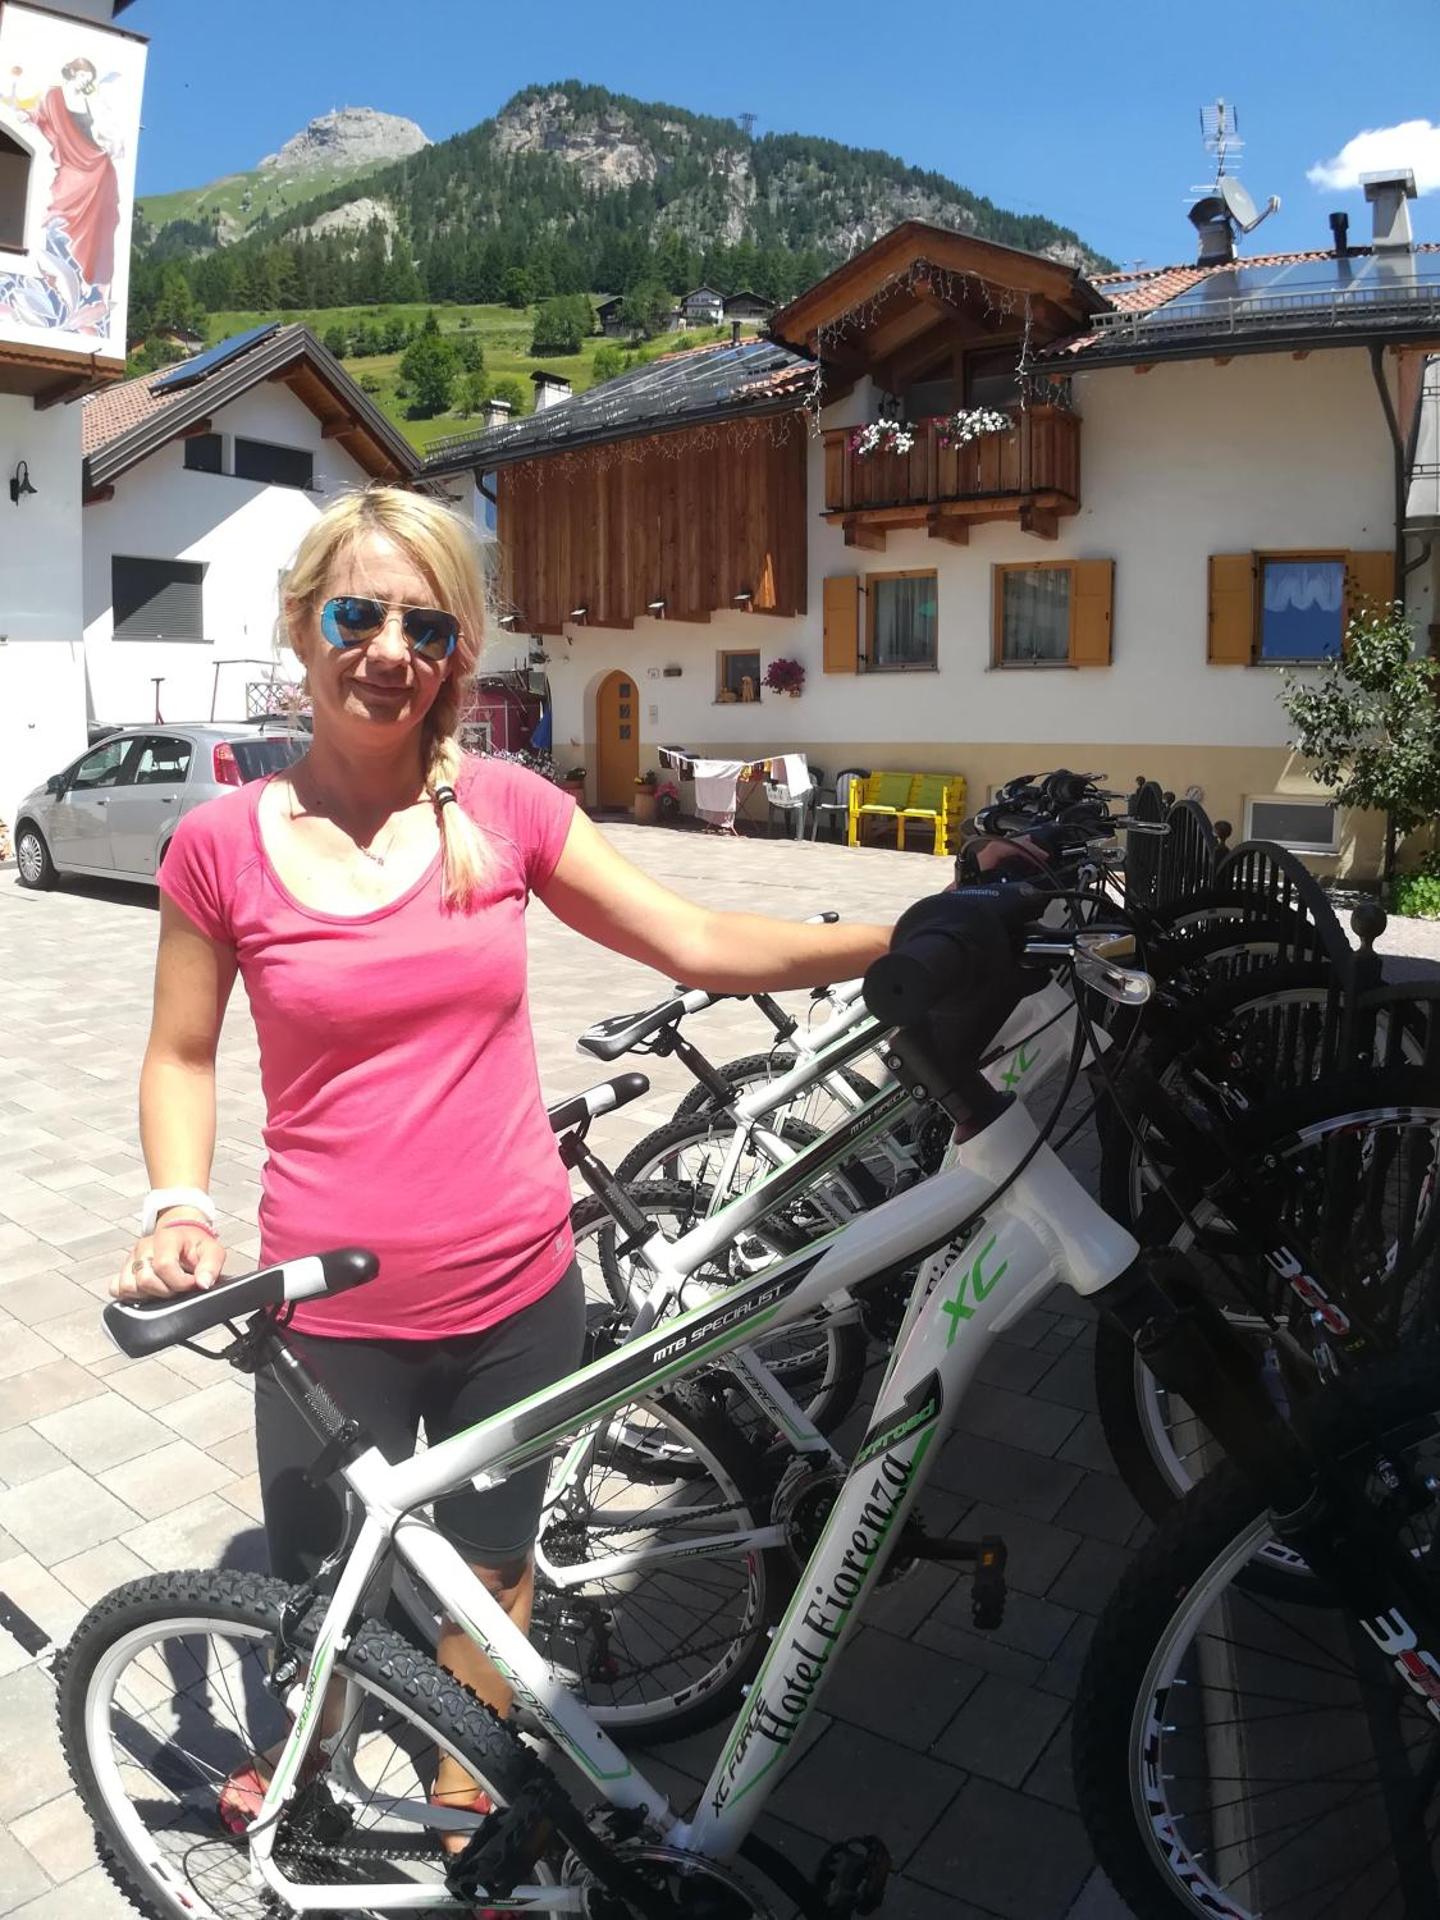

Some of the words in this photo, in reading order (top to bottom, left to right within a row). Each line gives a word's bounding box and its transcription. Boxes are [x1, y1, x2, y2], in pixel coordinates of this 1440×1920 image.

[653, 1337, 687, 1363] MTB
[690, 1283, 785, 1343] SPECIALIST
[941, 1235, 1008, 1349] XC
[756, 1637, 829, 1747] Hotel
[801, 1452, 913, 1642] Fiorenza
[711, 1776, 730, 1819] XC
[729, 1687, 767, 1782] FORCE
